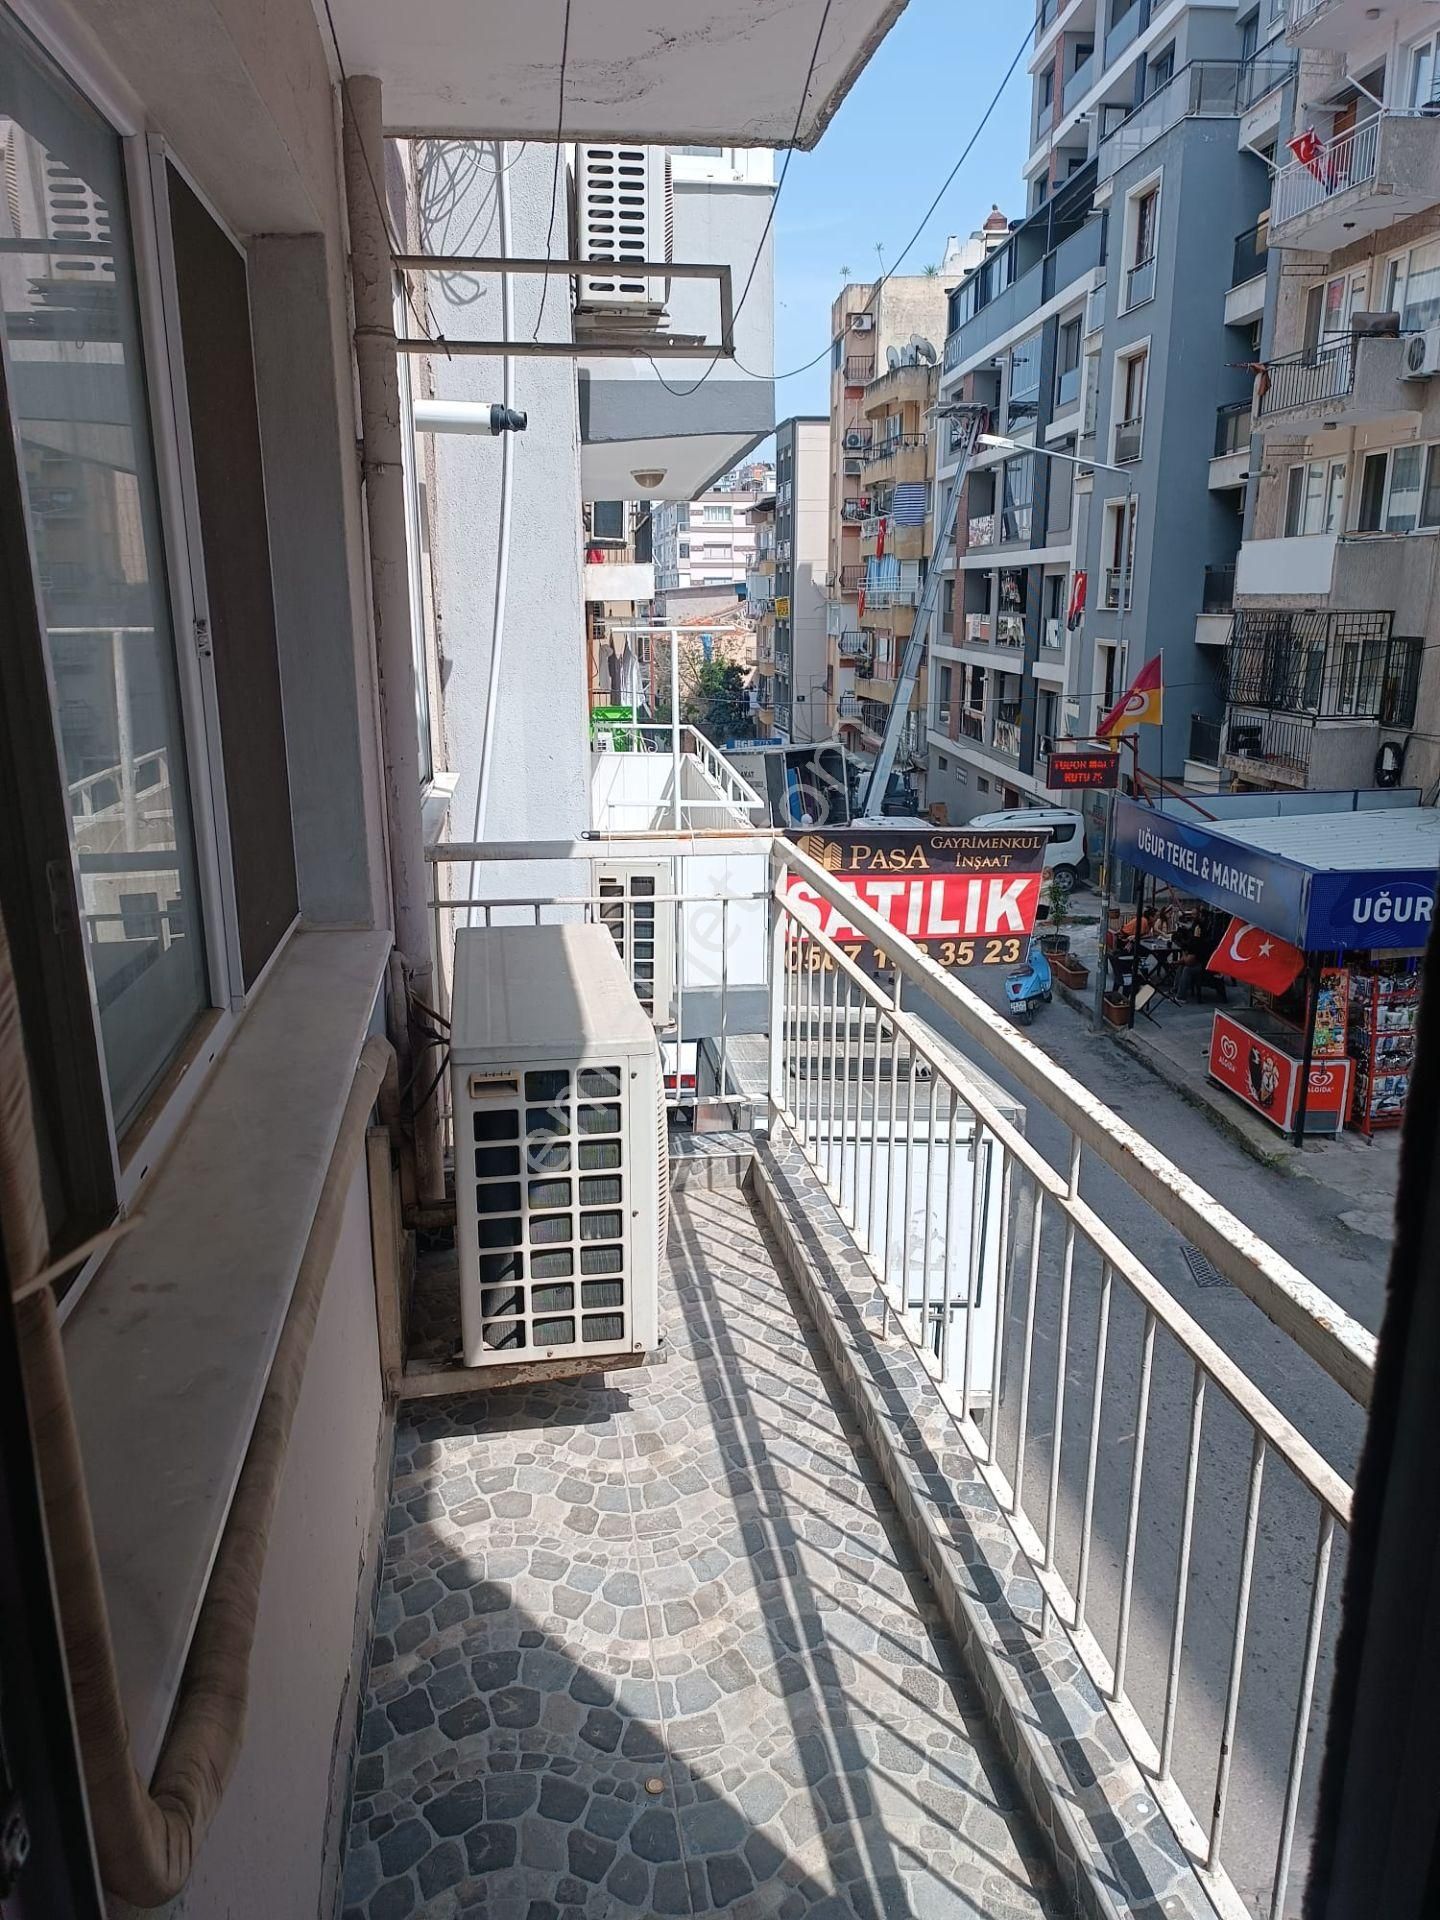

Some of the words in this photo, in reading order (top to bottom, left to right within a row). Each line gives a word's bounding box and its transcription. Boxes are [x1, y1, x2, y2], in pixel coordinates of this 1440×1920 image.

[931, 835, 1042, 850] GAYRİMENKUL
[955, 852, 1013, 871] İNŞAAT
[1137, 826, 1165, 860] UĞUR
[1166, 840, 1200, 876] TEKEL
[1201, 857, 1210, 881] &
[1211, 860, 1265, 904] MARKET
[1352, 891, 1434, 924] UĞUR
[785, 944, 862, 971] 057
[938, 942, 975, 966] 35
[983, 939, 1021, 964] 23
